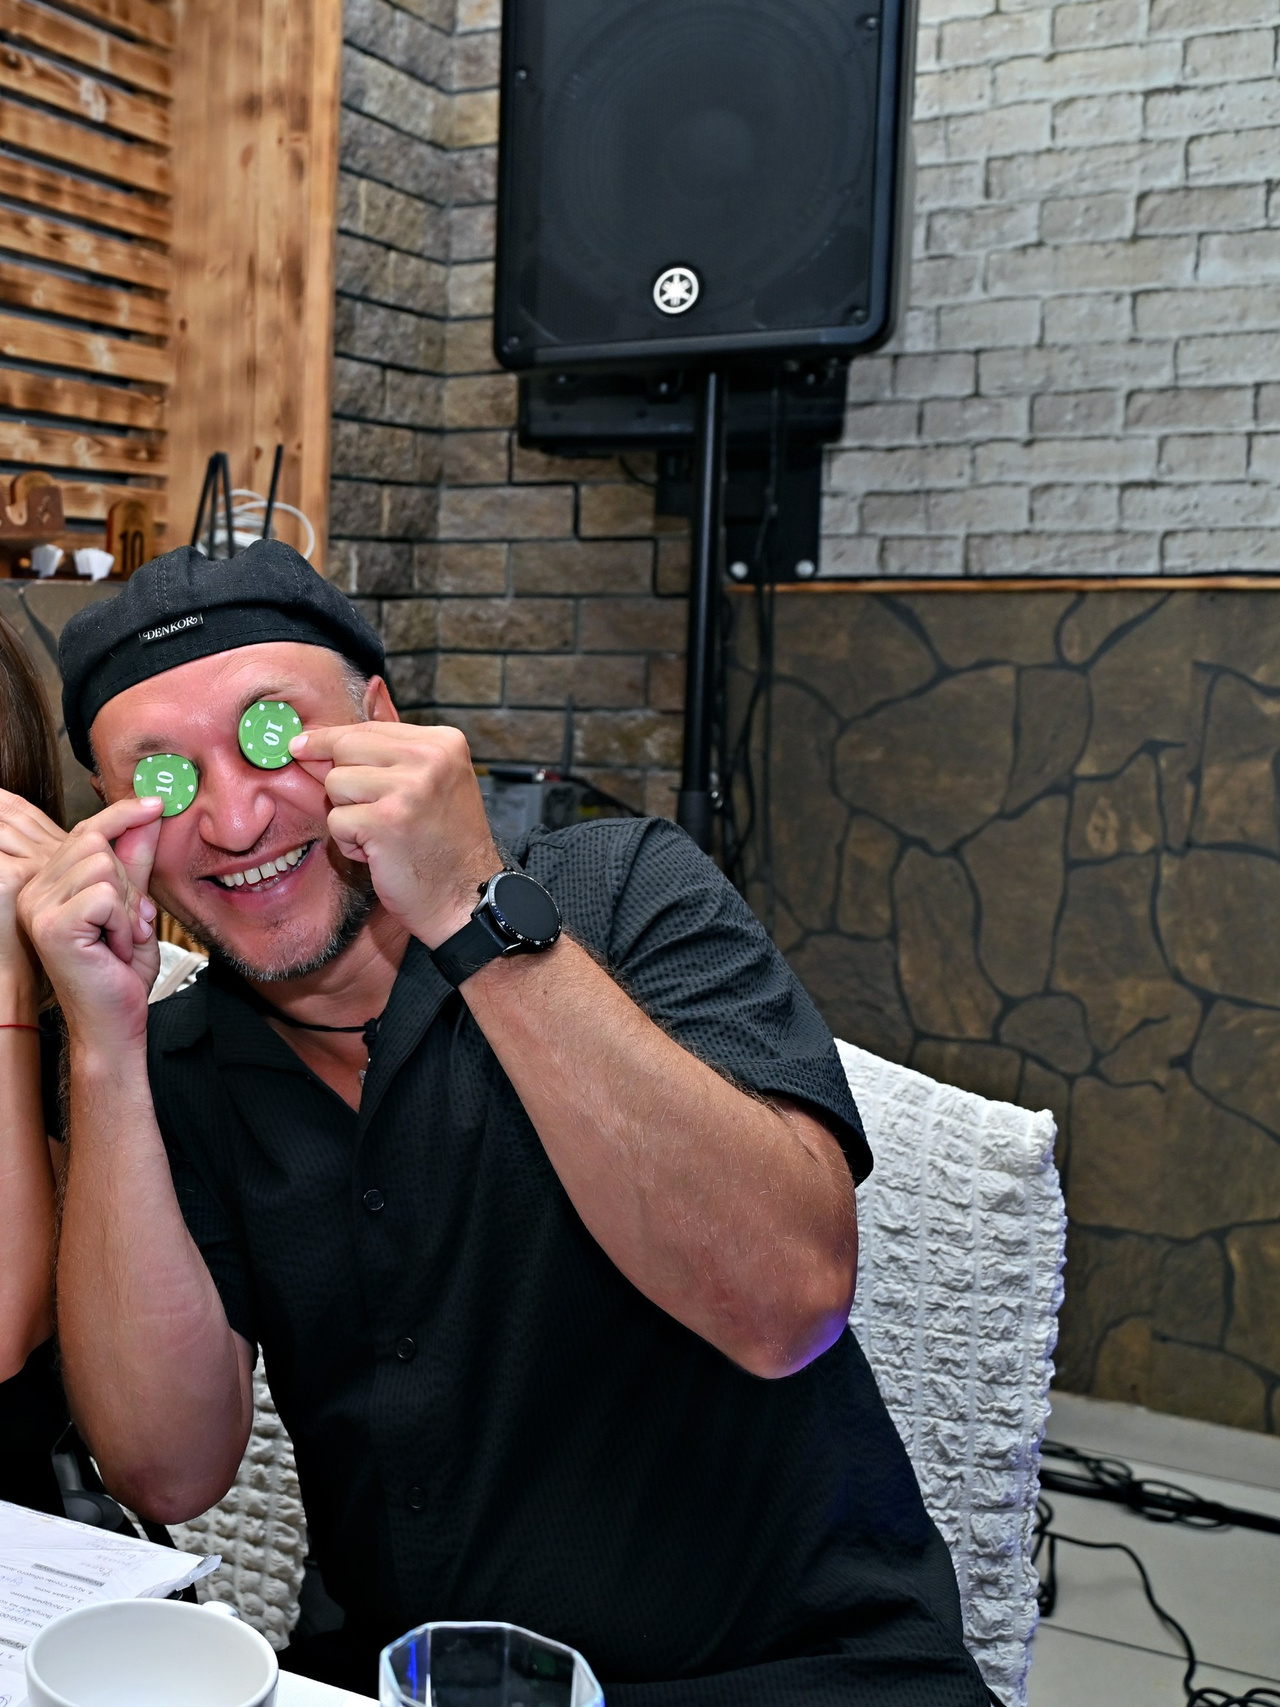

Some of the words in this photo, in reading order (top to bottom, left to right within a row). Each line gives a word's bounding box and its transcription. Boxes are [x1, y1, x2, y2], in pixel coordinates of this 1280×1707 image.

[142, 615, 198, 640] DENKOR
[262, 719, 284, 747] 10
[155, 770, 175, 796] 10
[16, 1570, 44, 1580] общего
